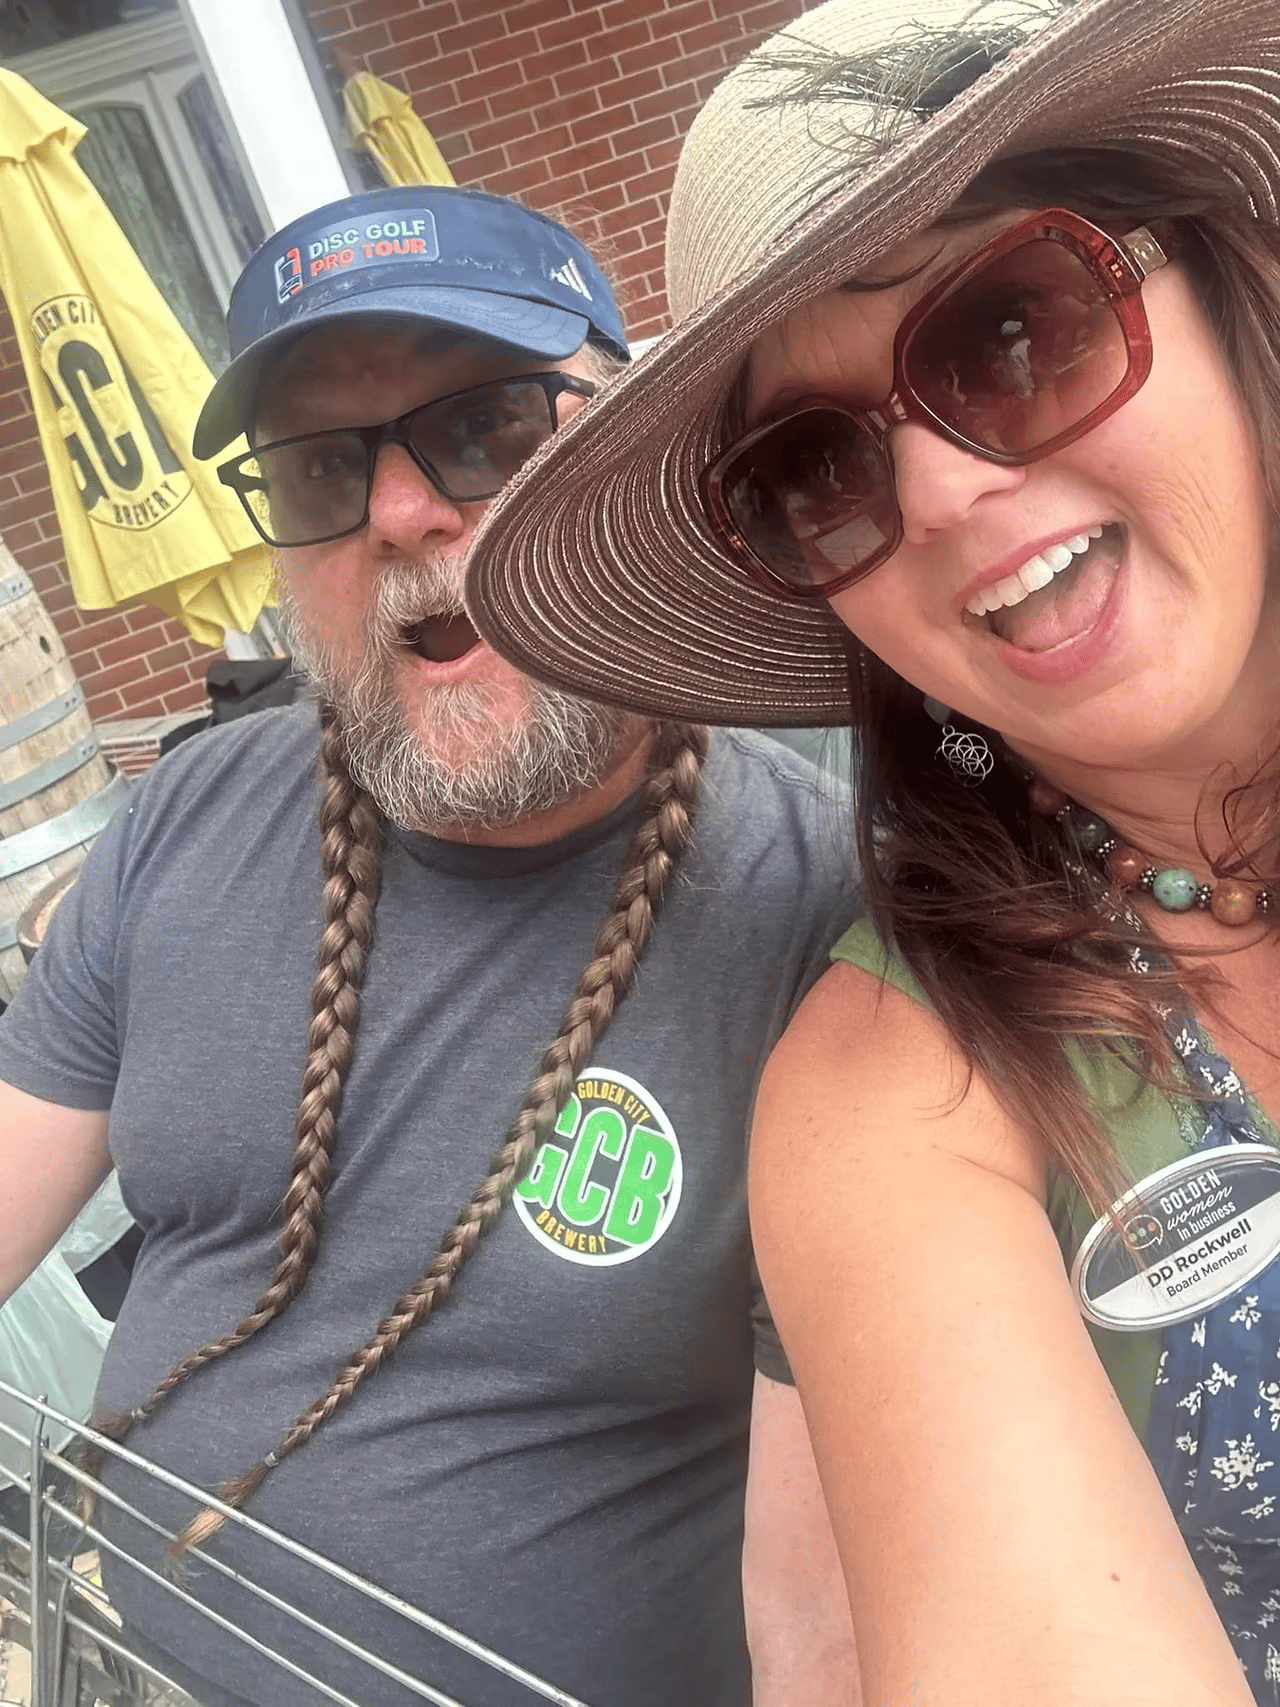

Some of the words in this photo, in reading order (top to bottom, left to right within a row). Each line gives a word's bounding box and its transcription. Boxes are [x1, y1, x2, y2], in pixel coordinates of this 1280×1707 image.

[308, 229, 359, 259] DISC
[366, 220, 426, 239] GOLF
[310, 248, 356, 276] PRO
[362, 238, 427, 258] TOUR
[577, 1080, 626, 1105] GOLDEN
[623, 1095, 652, 1126] CITY
[512, 1092, 677, 1247] GCB
[1159, 1168, 1222, 1215] GOLDEN
[535, 1209, 606, 1253] BREWERY
[1166, 1185, 1233, 1231] women
[1188, 1201, 1237, 1235] business
[1147, 1265, 1174, 1289] DD
[1174, 1218, 1252, 1272] Rockwell
[1166, 1269, 1202, 1298] Board
[1202, 1244, 1249, 1277] Member
